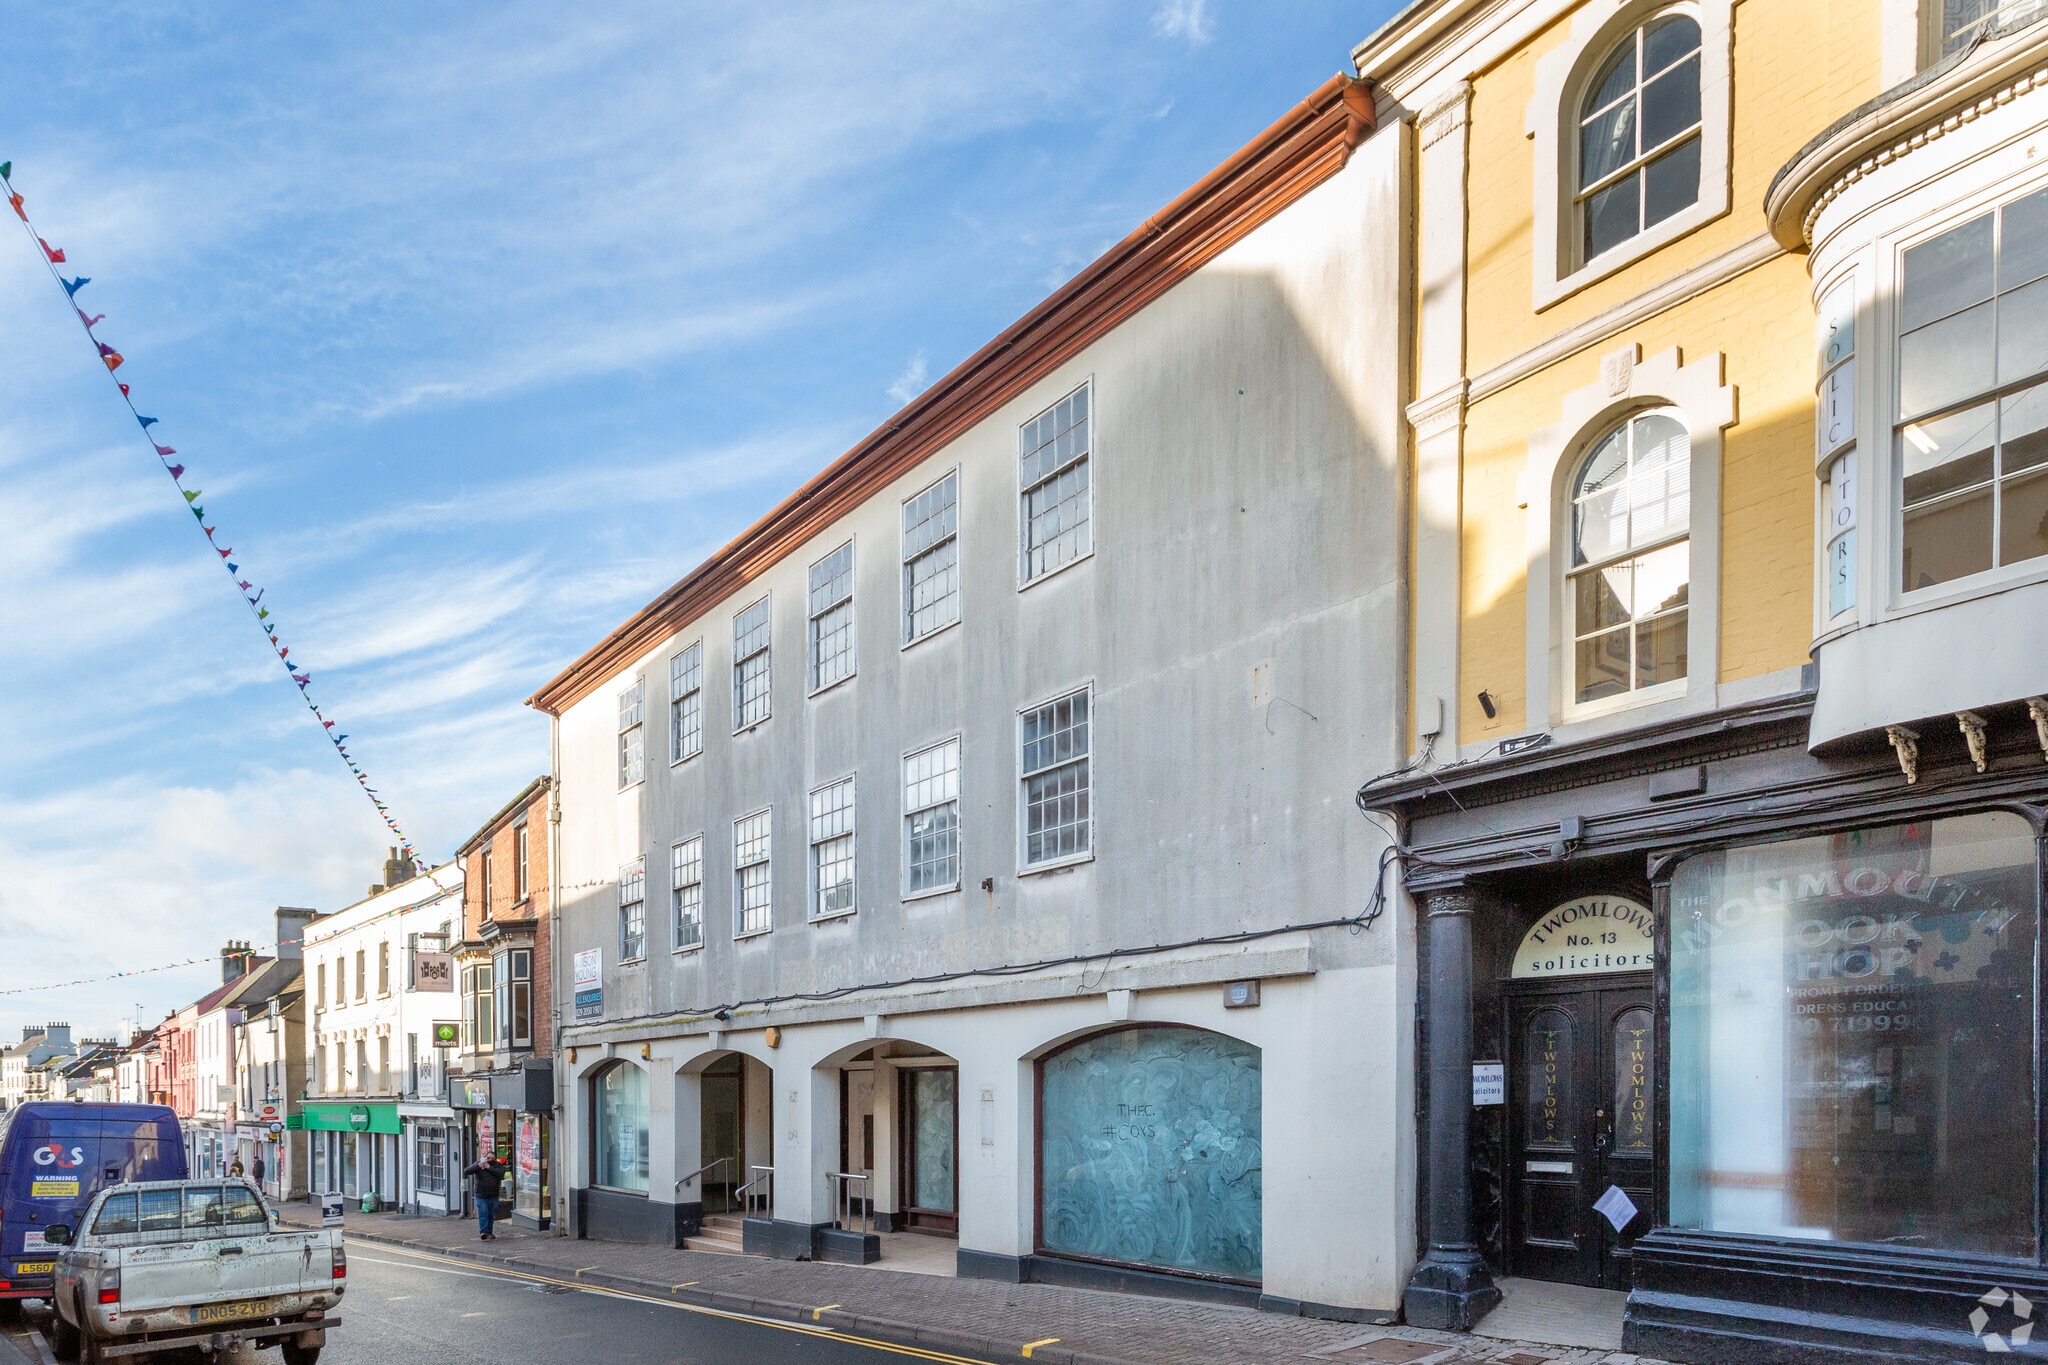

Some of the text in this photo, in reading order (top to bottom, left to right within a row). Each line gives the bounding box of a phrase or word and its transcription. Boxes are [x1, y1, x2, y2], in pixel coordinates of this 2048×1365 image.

[1826, 316, 1851, 584] SOLICITORS
[1677, 895, 1709, 908] THE
[1530, 901, 1655, 946] TWOMLOWS
[1567, 932, 1617, 946] No. 13
[1532, 953, 1655, 972] solicitors
[1543, 1040, 1557, 1131] TWOMLOWS
[1631, 1040, 1645, 1134] TWOMLOWS
[471, 1087, 487, 1105] millets
[1102, 1123, 1156, 1141] #COYS
[33, 1143, 84, 1168] G4S
[132, 1255, 171, 1263] MITSUBISHI
[22, 1264, 50, 1273] LS60
[199, 1304, 237, 1321] DN05
